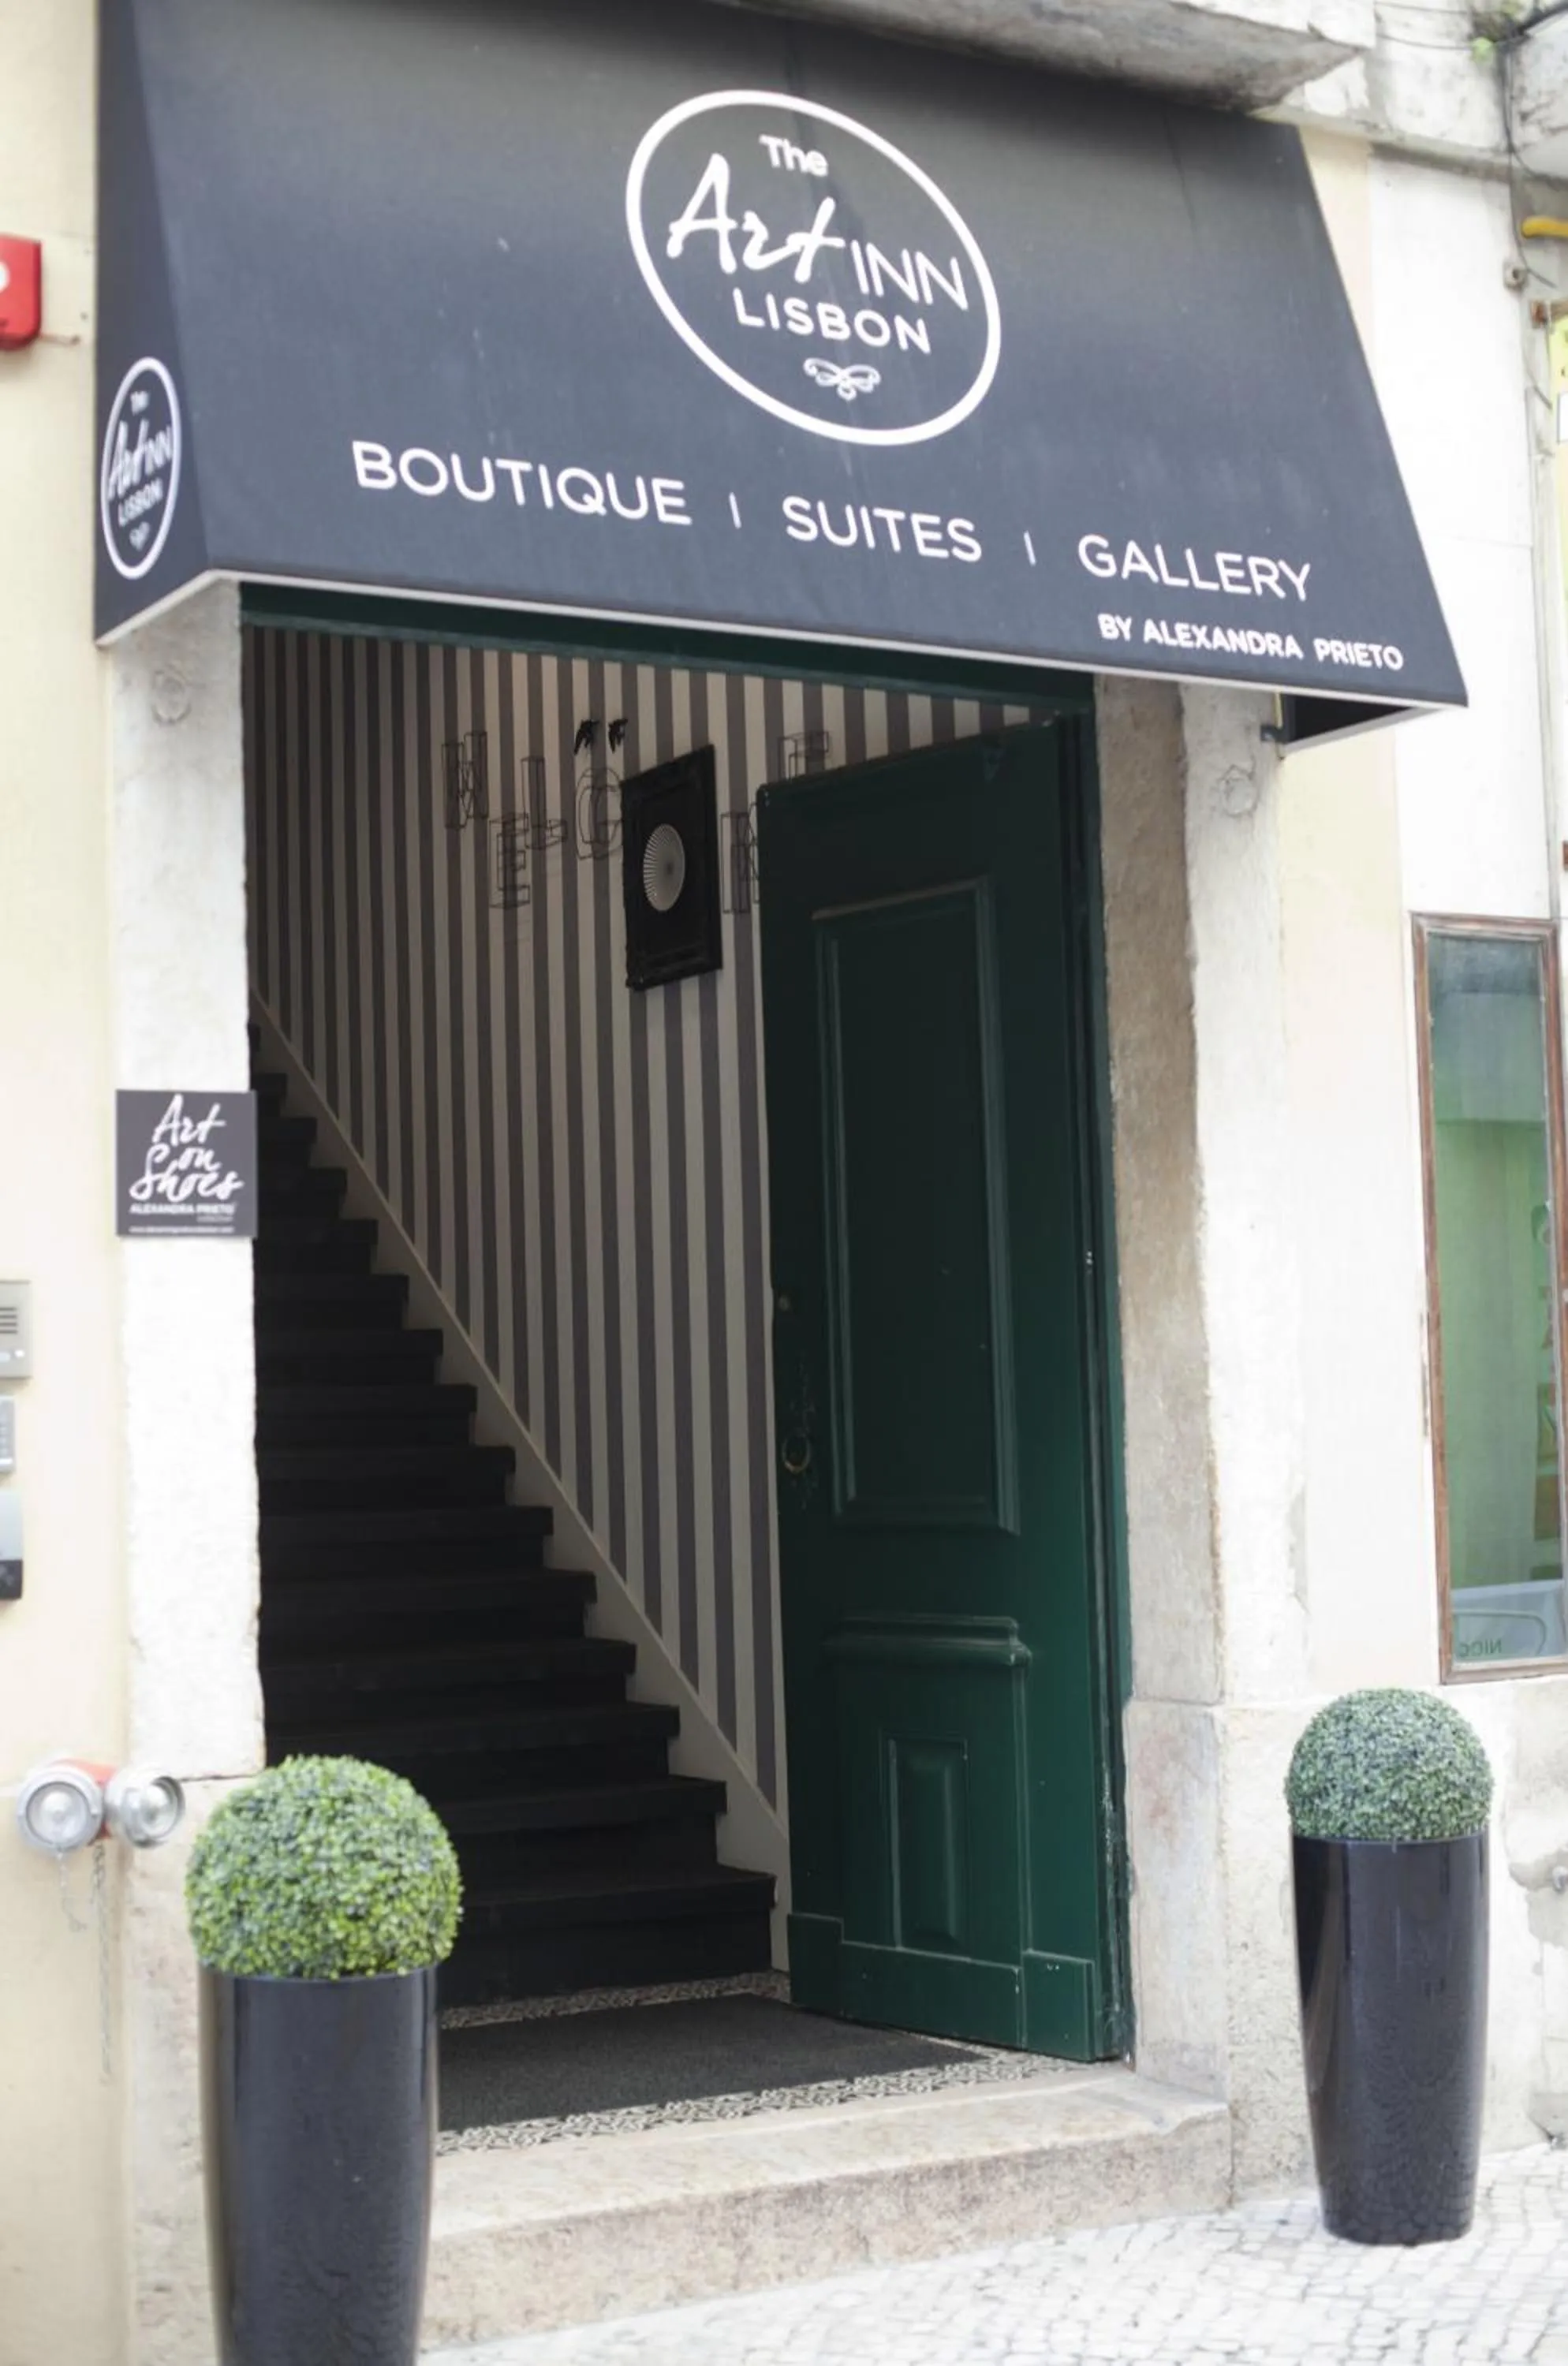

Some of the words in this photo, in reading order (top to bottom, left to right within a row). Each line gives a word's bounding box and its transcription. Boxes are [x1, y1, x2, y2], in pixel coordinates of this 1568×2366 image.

[759, 134, 828, 177] The
[850, 240, 969, 310] INN
[733, 287, 931, 354] LISBON
[352, 440, 693, 525] BOUTIQUE
[782, 496, 982, 562] SUITES
[1078, 534, 1311, 602] GALLERY
[1097, 613, 1132, 641] BY
[1143, 618, 1304, 659] ALEXANDRA
[1312, 637, 1404, 670] PRIETO
[151, 1093, 227, 1148] Art
[128, 1143, 245, 1203] Shoes
[177, 1146, 222, 1172] on
